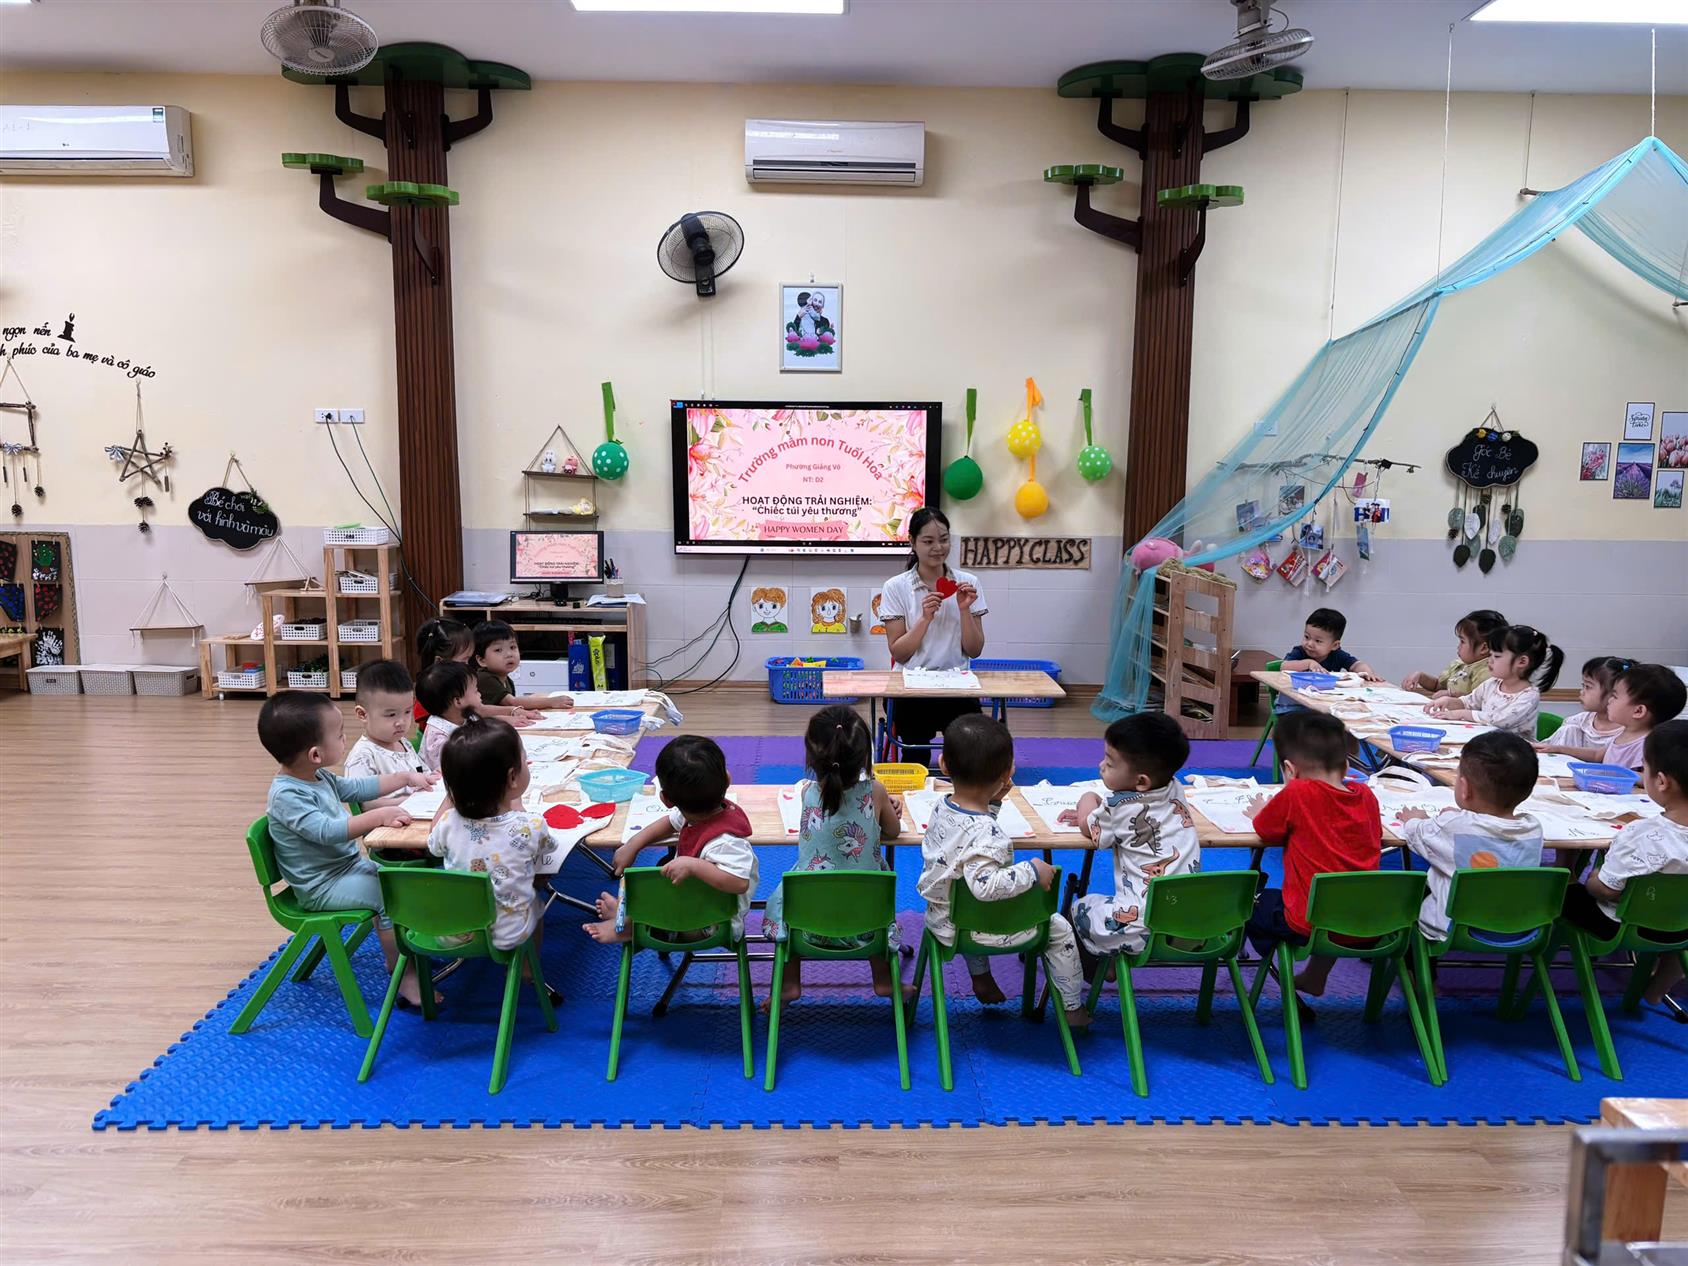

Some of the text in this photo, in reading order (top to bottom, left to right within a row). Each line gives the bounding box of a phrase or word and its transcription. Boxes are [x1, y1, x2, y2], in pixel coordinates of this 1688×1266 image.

[2, 322, 52, 341] ngọn nến
[12, 342, 37, 359] phúc
[42, 343, 60, 355] của
[66, 344, 80, 358] ba
[82, 352, 99, 364] mẹ
[101, 355, 114, 366] và
[117, 359, 130, 370] cô
[127, 366, 156, 378] giáo
[738, 447, 778, 483] Trường
[811, 437, 835, 448] non
[742, 495, 872, 507] HOẠT ĐỘNG TRẢI NGHIỆM:
[786, 506, 799, 515] túi
[801, 506, 819, 517] yêu
[961, 537, 1088, 566] HAPPY CLASS
